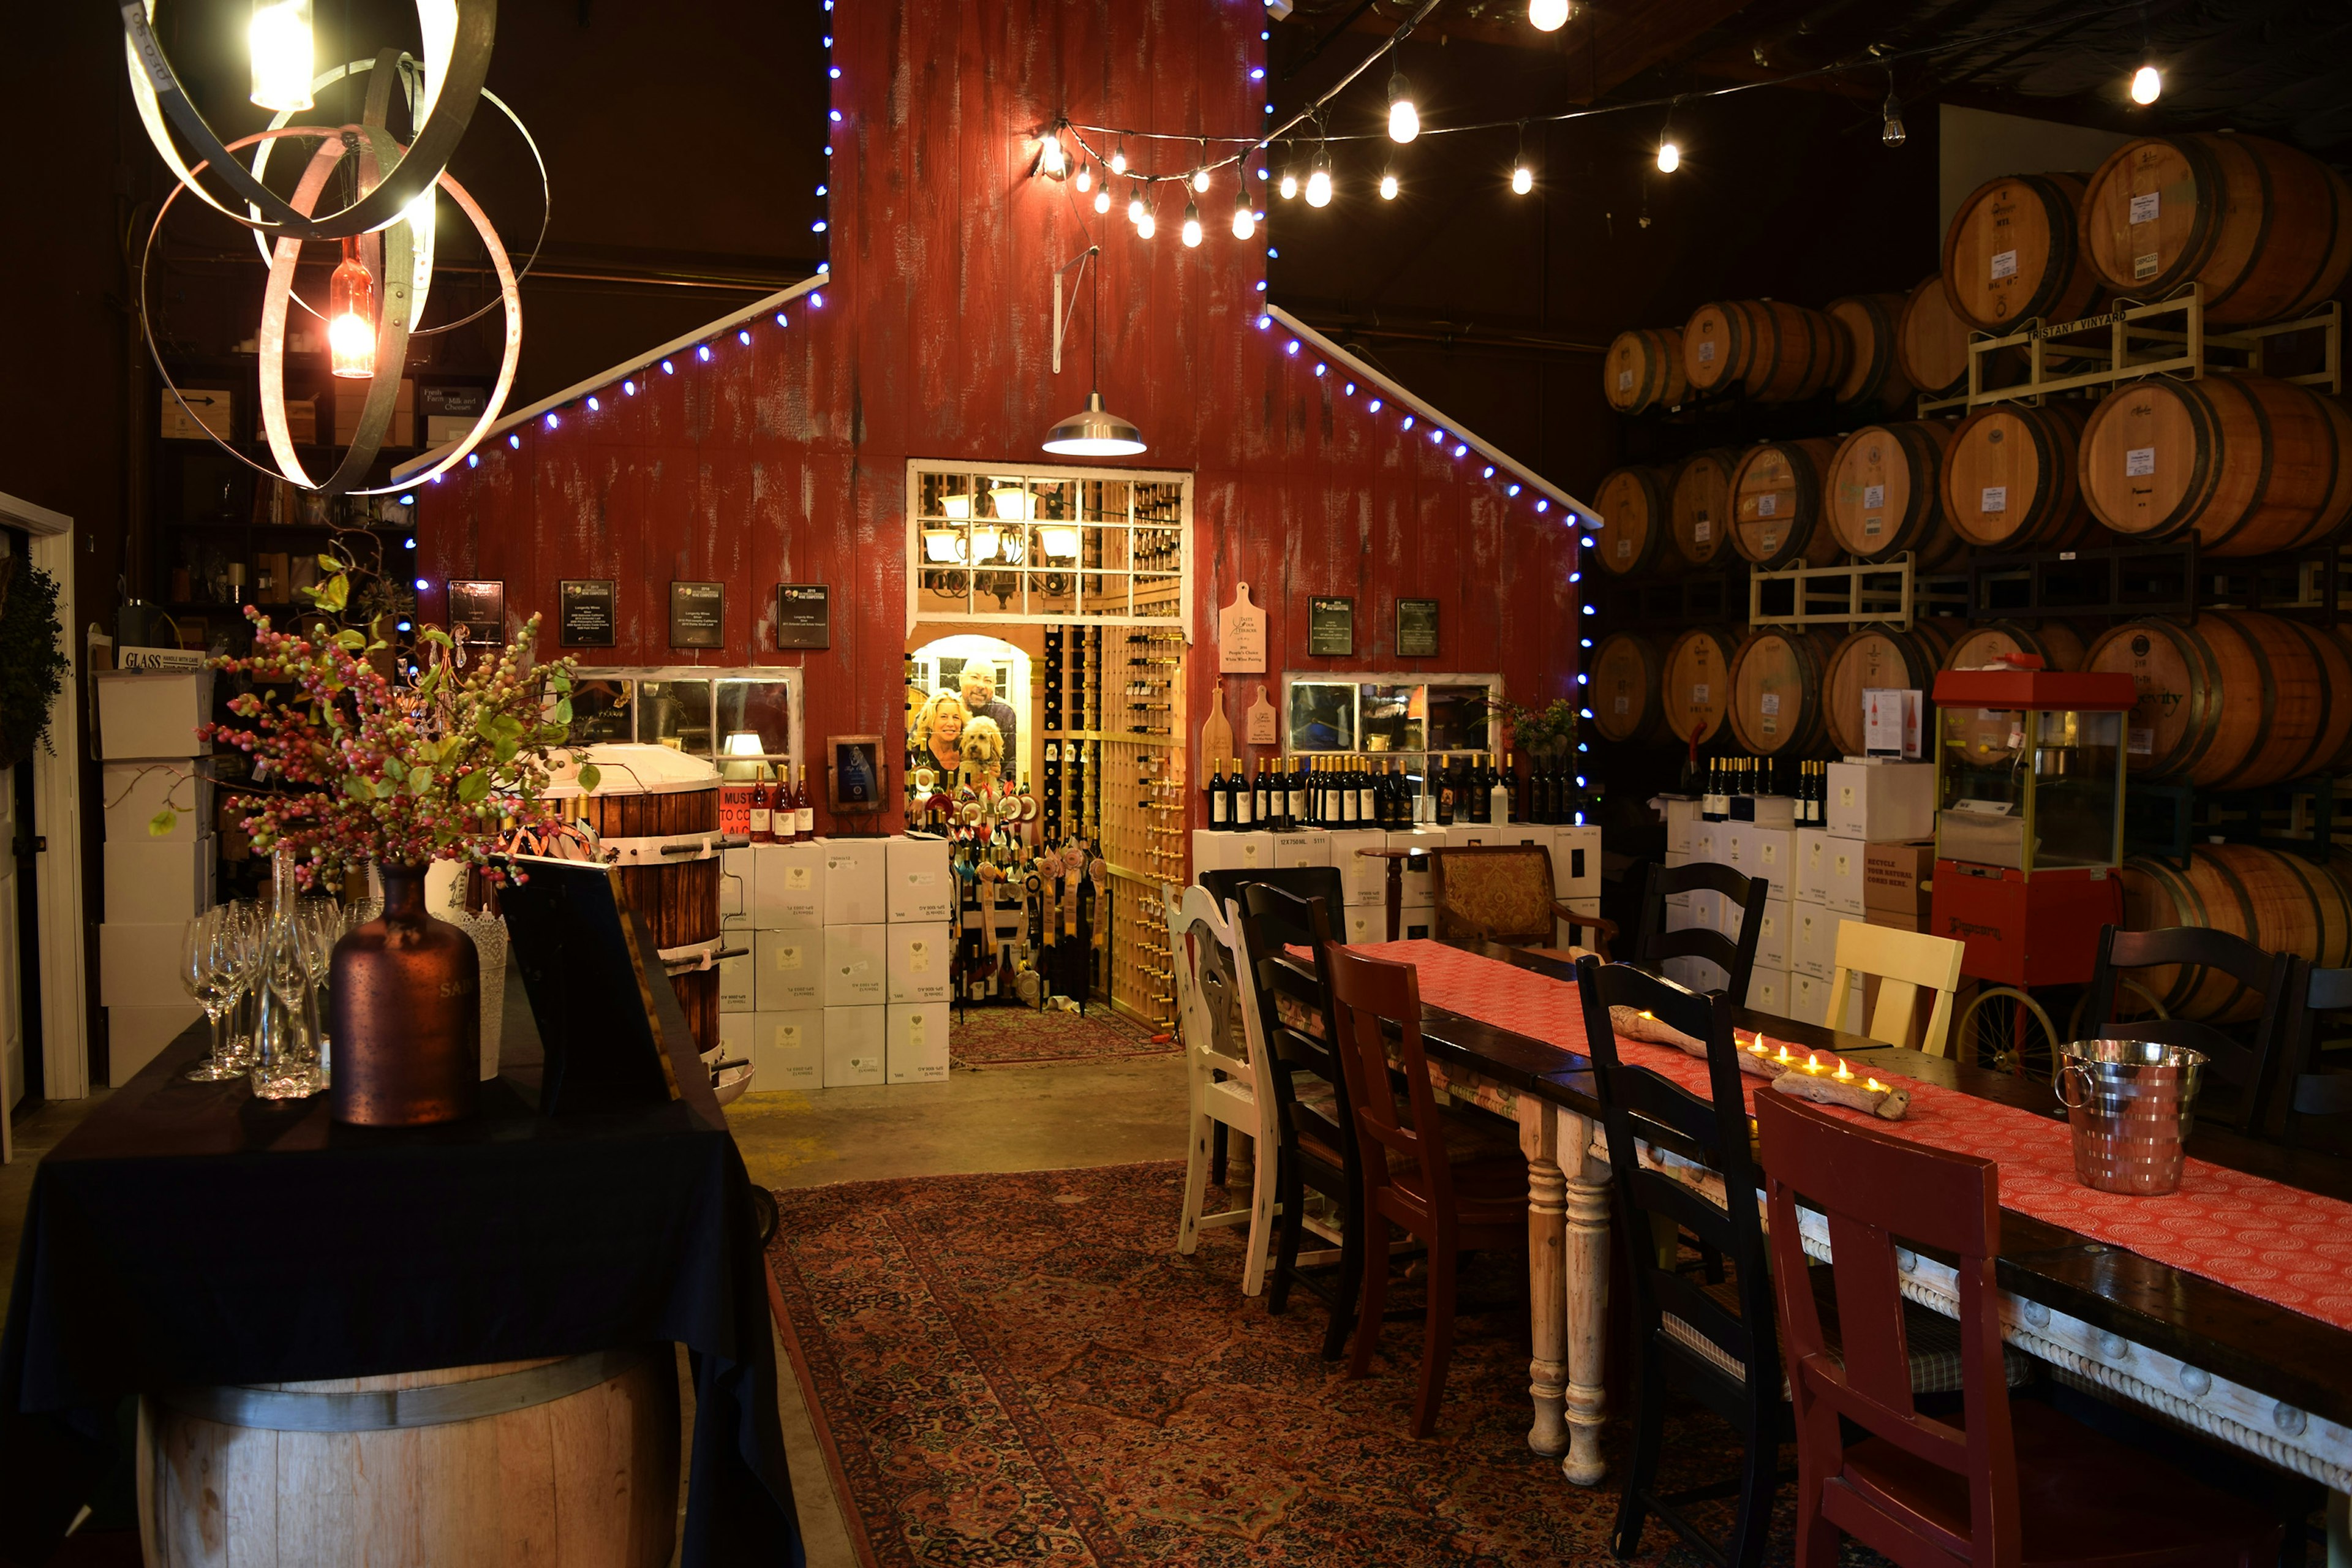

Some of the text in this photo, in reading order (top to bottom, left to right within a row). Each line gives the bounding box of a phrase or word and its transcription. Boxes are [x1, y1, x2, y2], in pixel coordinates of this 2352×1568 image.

[2027, 311, 2126, 341] TRISTANT VINYARD
[126, 652, 161, 669] GLASS
[725, 793, 753, 804] MUST
[720, 809, 733, 821] TO
[1868, 858, 1896, 867] RECYCLE
[1885, 870, 1913, 879] NATURAL
[1948, 916, 2003, 941] Popcorn
